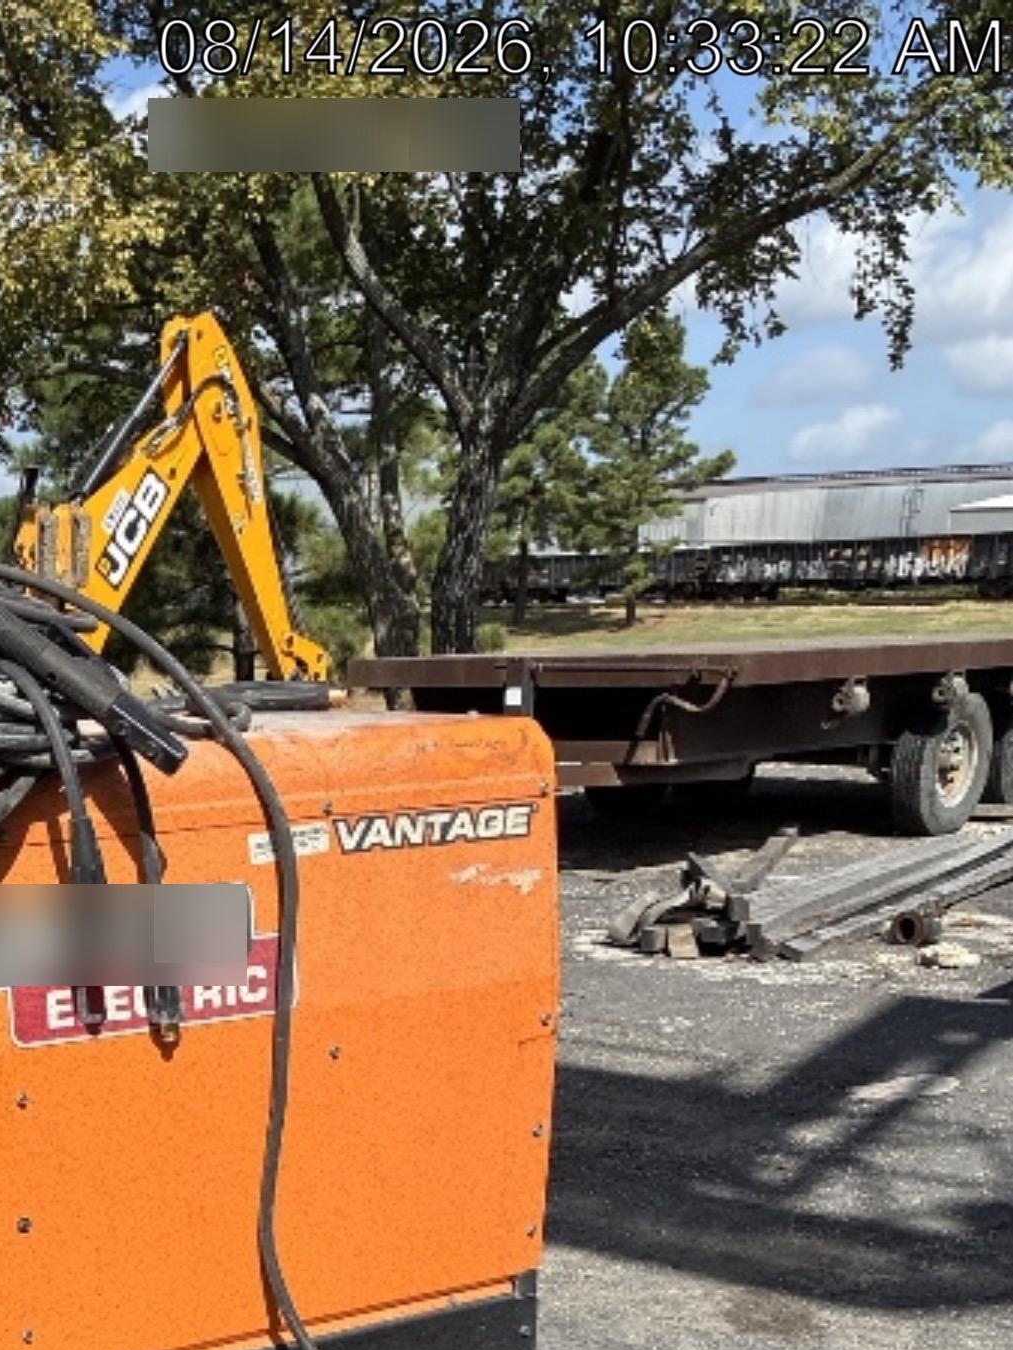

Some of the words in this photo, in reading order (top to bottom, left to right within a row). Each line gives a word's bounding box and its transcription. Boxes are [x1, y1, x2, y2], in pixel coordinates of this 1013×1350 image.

[95, 467, 170, 589] JCB
[332, 804, 535, 854] VANTAGE
[46, 965, 267, 1030] ELERIC
